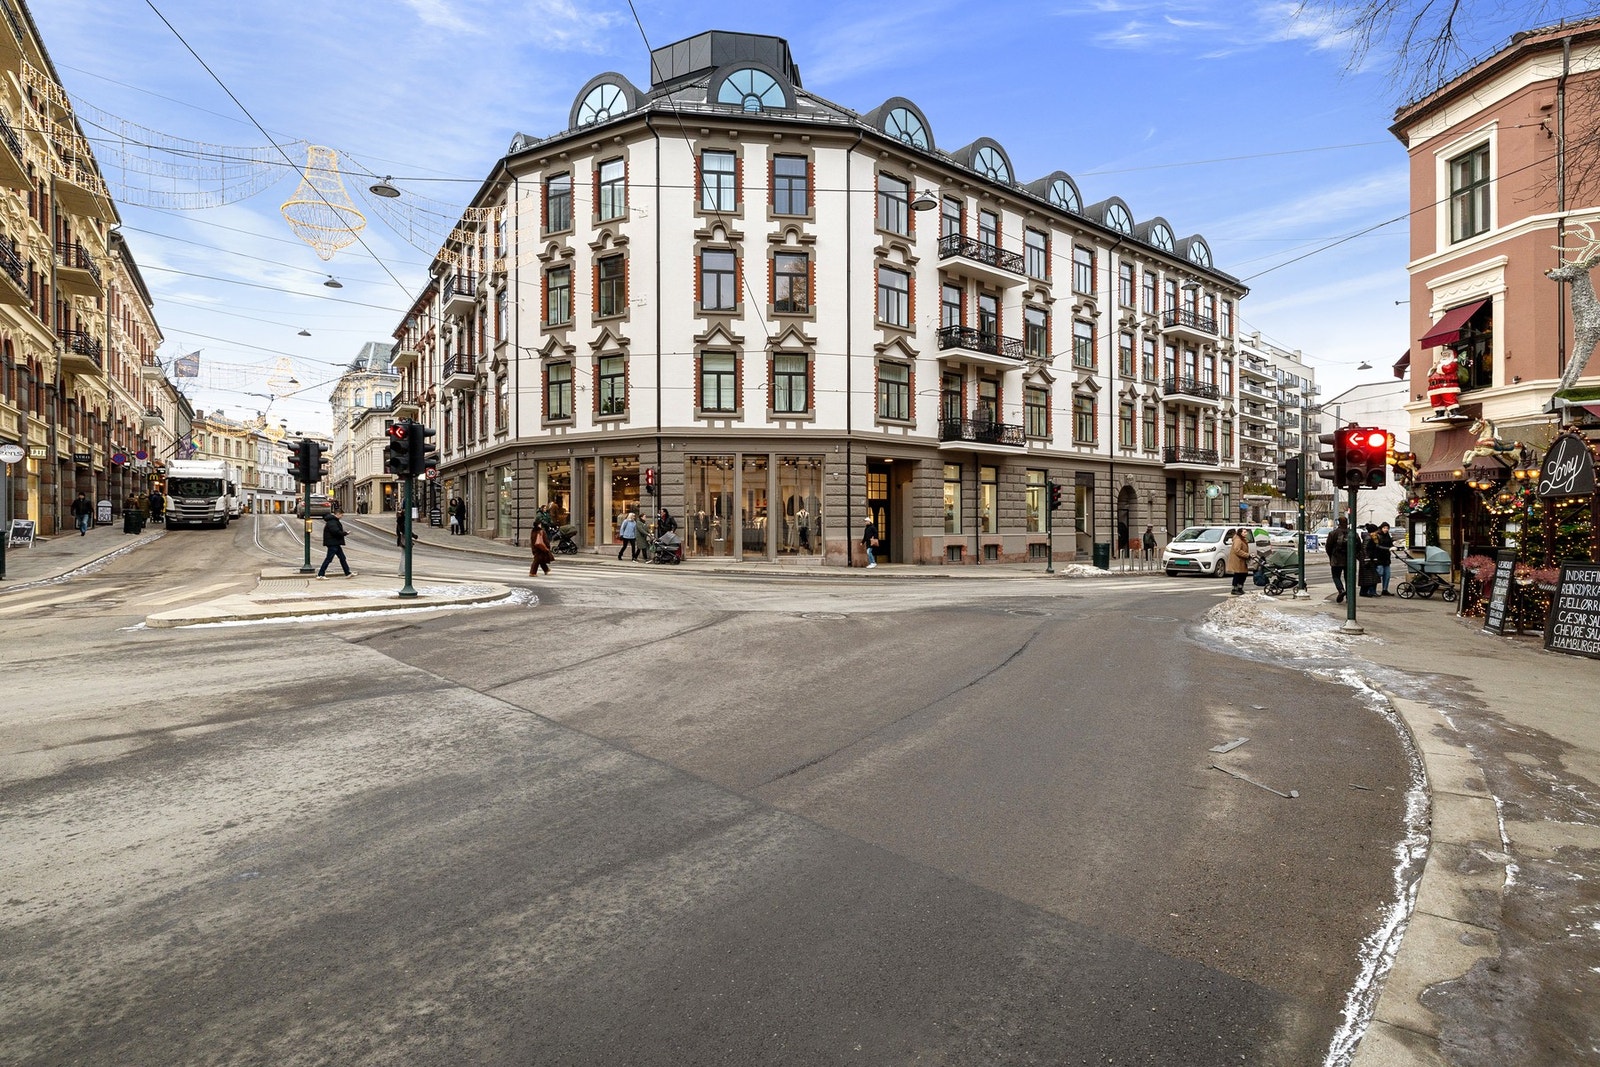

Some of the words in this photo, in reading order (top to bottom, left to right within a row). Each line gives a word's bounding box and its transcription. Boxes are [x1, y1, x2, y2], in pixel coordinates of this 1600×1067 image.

[1558, 596, 1600, 611] FJELLØRR
[1558, 611, 1587, 625] CÆSAR
[1553, 624, 1585, 638] CHEVRE
